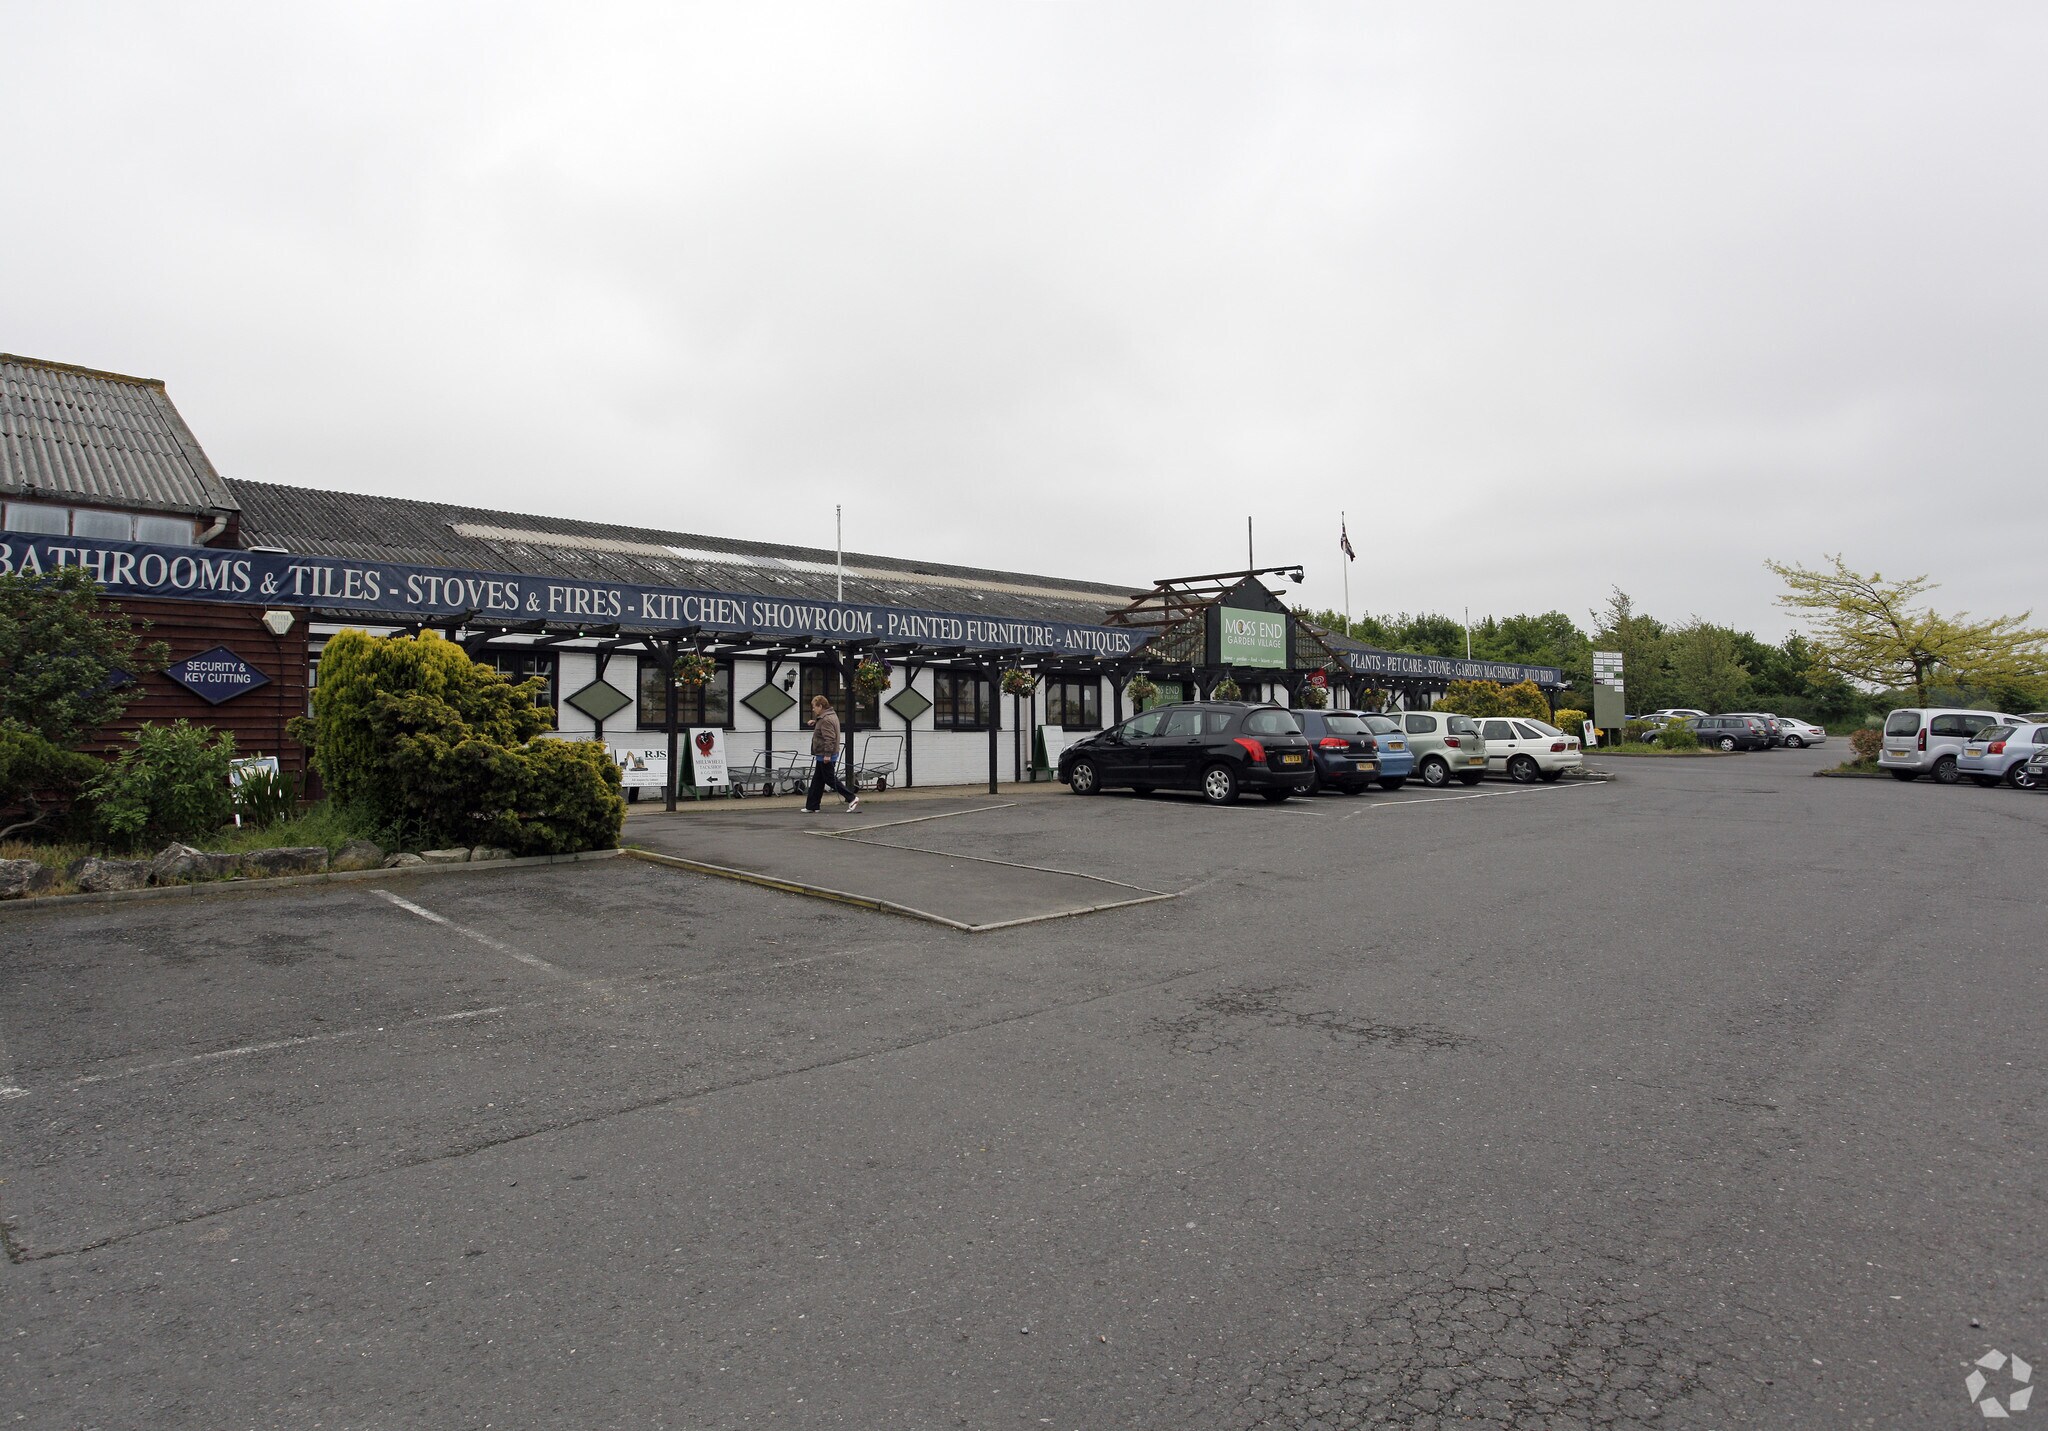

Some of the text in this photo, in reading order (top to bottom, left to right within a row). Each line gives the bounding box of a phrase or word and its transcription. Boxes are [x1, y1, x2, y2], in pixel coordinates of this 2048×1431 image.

[260, 572, 279, 595] &
[288, 565, 381, 601] TILES
[406, 574, 519, 611] STOVES
[525, 591, 541, 612] &
[547, 585, 622, 617] FIRES
[641, 593, 748, 626] KITCHEN
[752, 601, 873, 634] SHOWROOM
[887, 613, 963, 640] PAINTED
[966, 620, 1053, 647] FURNITURE
[1064, 629, 1131, 657] ANTIQUES
[1225, 618, 1282, 639] MOSS END
[1227, 635, 1281, 648] GARDEN VILLAGE
[186, 661, 246, 672] SECURITY &
[1350, 652, 1381, 671] PLANTS
[1387, 656, 1401, 672] PET
[1402, 657, 1423, 673] CARE
[1428, 659, 1451, 675] STONE
[1455, 662, 1483, 678] GARDEN
[1483, 665, 1520, 680] MACHINERY
[184, 672, 251, 684] KEY CUTTING
[1165, 685, 1180, 695] END
[644, 750, 667, 758] RJS
